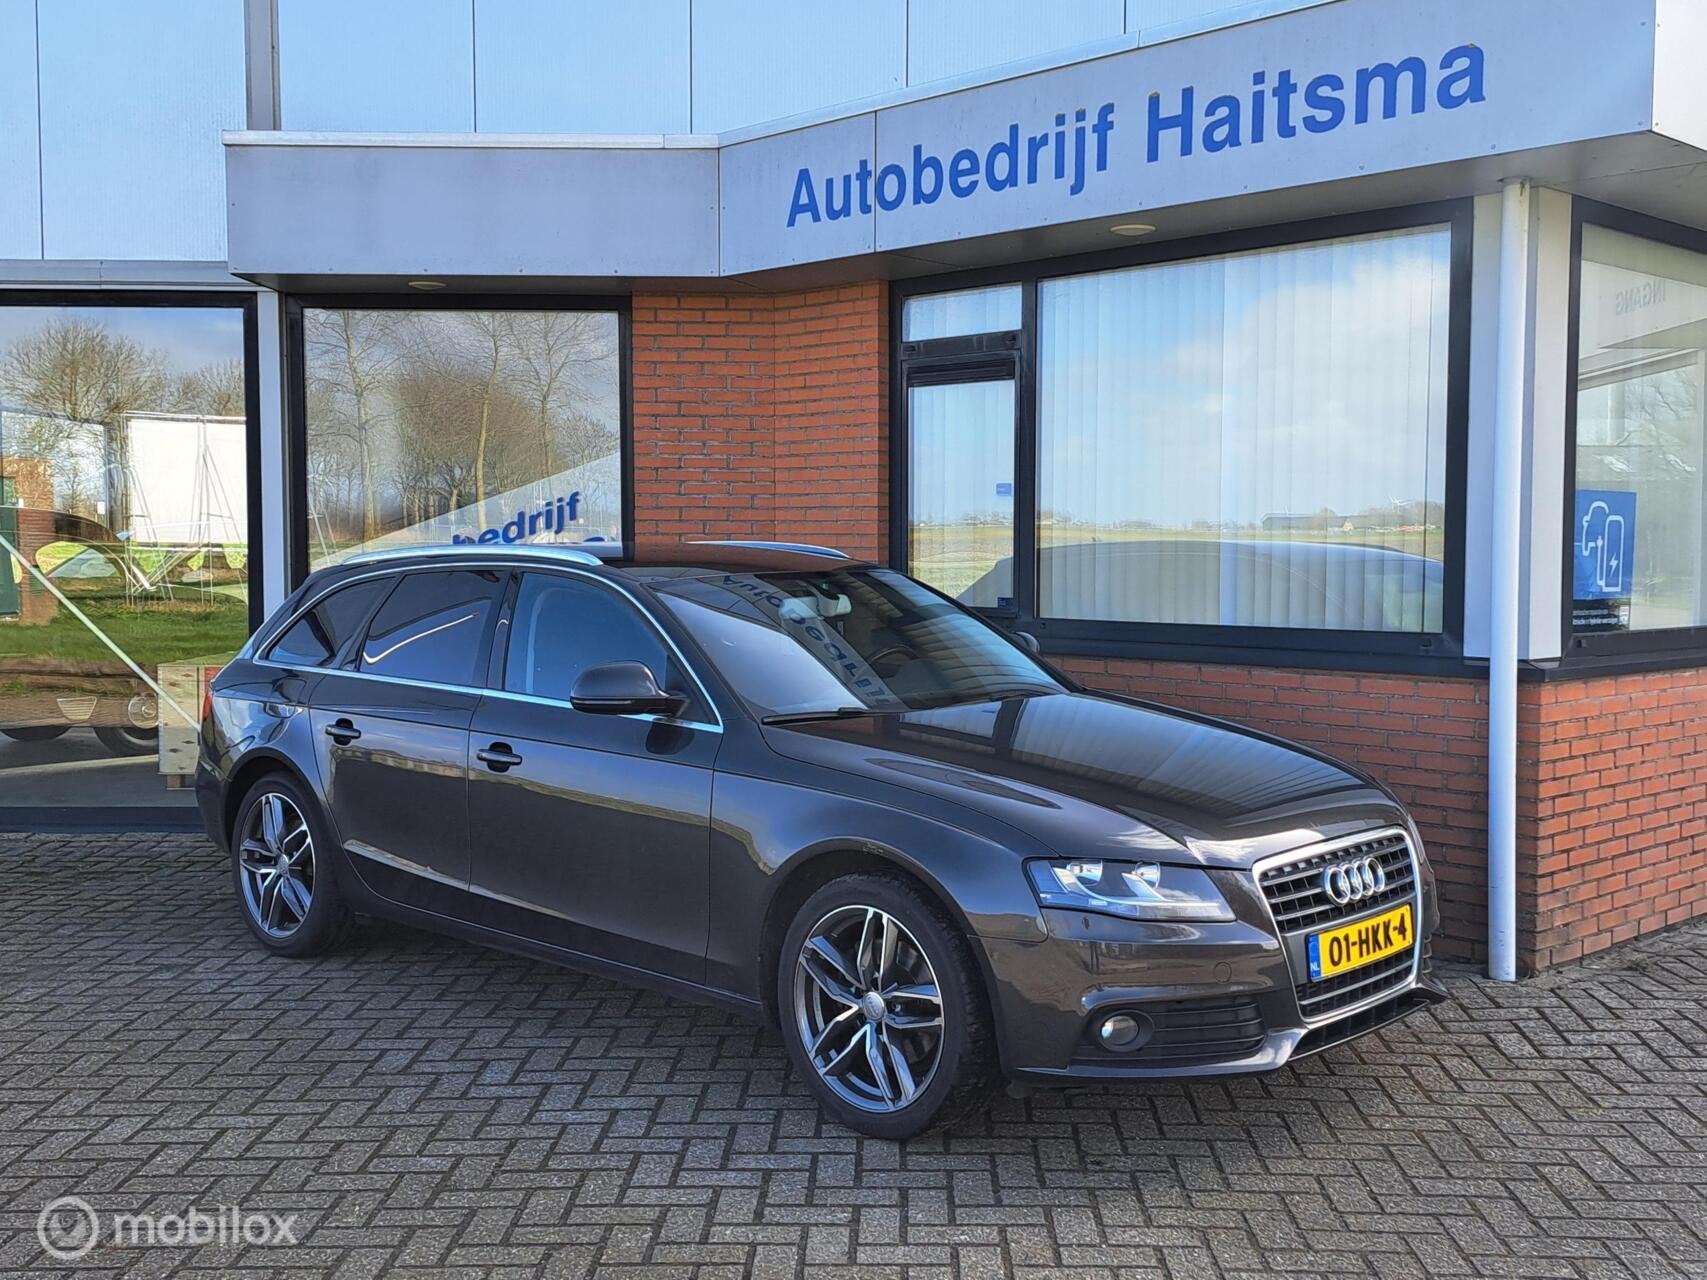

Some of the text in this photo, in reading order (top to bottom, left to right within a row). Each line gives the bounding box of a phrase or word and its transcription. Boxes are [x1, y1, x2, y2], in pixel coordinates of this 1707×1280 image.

[785, 43, 1486, 228] Autobedrijf Haitsma
[1310, 960, 1320, 972] NL
[1329, 913, 1407, 967] 01-HKK-4
